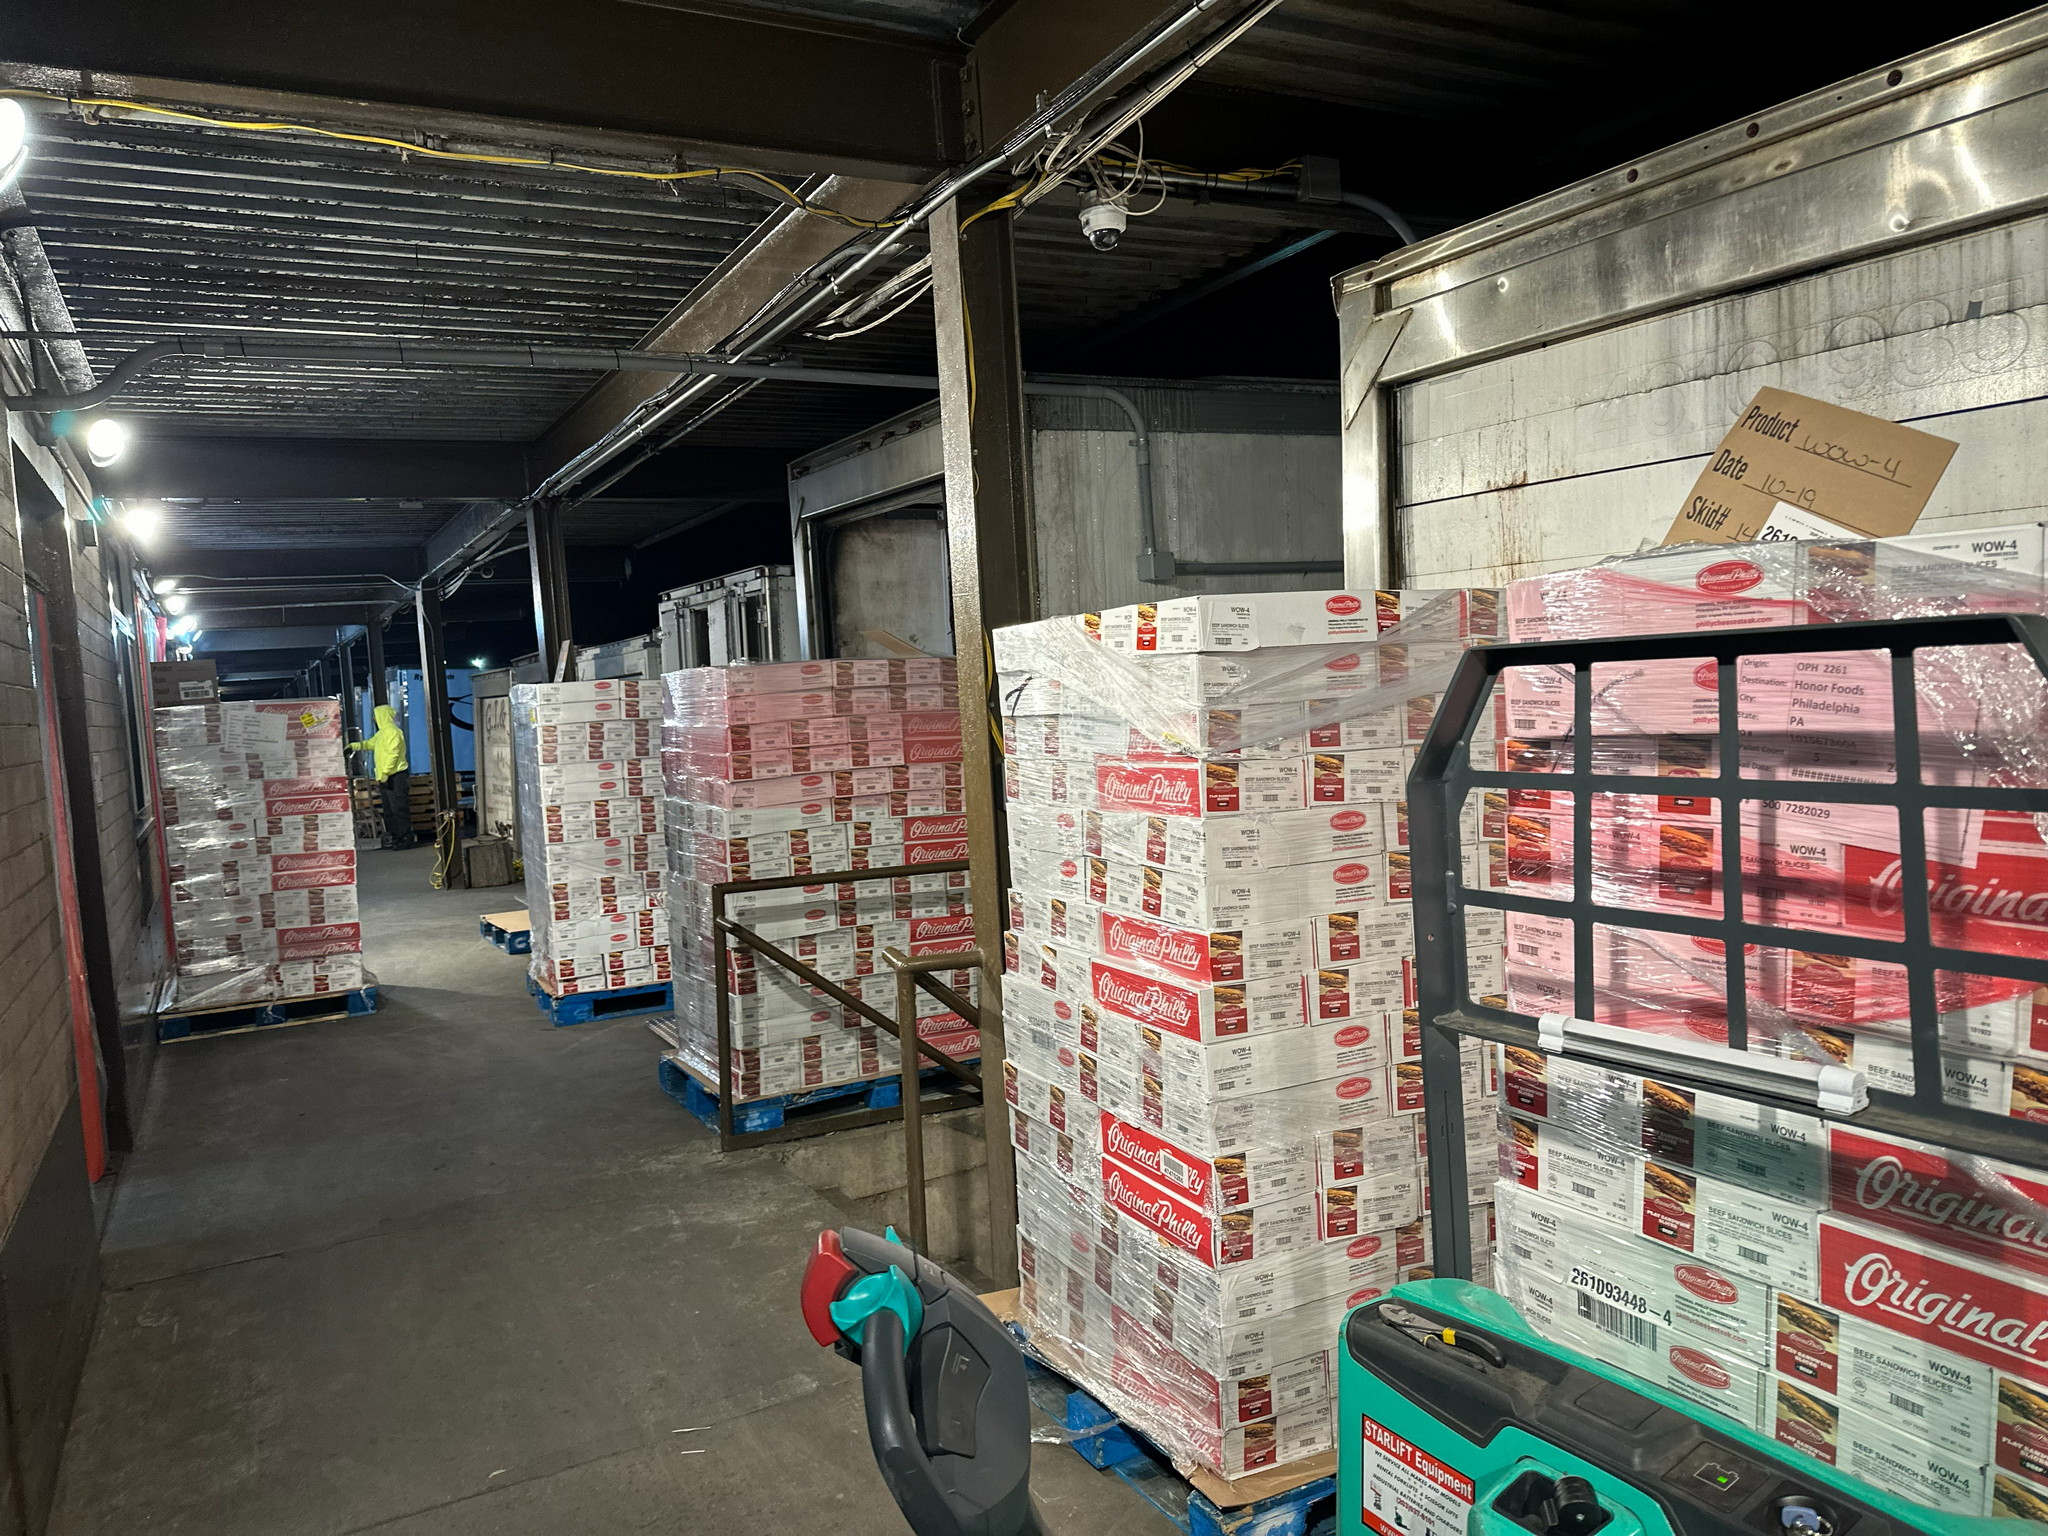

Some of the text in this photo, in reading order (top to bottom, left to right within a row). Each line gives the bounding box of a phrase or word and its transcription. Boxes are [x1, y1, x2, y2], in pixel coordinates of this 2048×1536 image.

[1741, 405, 1799, 443] Product
[1712, 448, 1748, 481] Date
[1686, 495, 1732, 531] Skid#
[1972, 540, 2017, 553] WOW-4
[1966, 560, 1998, 569] SLICES
[1695, 616, 1773, 629] phillycheesesteak.com
[1743, 658, 1848, 675] Origin: OPH 2261
[1741, 675, 1864, 696] Destination: Honor Foods
[1739, 693, 1860, 714] City: Philadelphia
[908, 717, 954, 735] Original
[1737, 711, 1804, 727] State: PA
[910, 743, 955, 760] Original
[1751, 762, 1772, 772] Date:
[1104, 772, 1192, 805] Original Philly
[272, 798, 343, 815] Original Philly
[1786, 803, 1830, 819] 7282029
[910, 820, 958, 838] Original
[911, 846, 958, 864] Original
[1790, 845, 1826, 857] WOW-4
[278, 853, 349, 870] Original Philly
[1745, 857, 1811, 870] SANDWICH SLICES
[278, 872, 350, 889] Original Philly
[284, 926, 356, 943] Original Philly
[916, 921, 962, 940] Original
[1283, 930, 1301, 938] WOW-4
[1525, 926, 1546, 935] SANDWICH
[1546, 929, 1562, 938] SLICES
[1110, 920, 1201, 970] Original Philly
[1872, 967, 1893, 977] BEEF
[1099, 971, 1191, 1026] Original Philly
[1536, 983, 1562, 996] WOW-4
[1232, 1046, 1251, 1055] WOW-4
[1868, 1064, 1889, 1076] BEEF
[1944, 1067, 1988, 1088] WOW-4
[1707, 1120, 1791, 1151] BEEF SANDWICH SLICES
[1770, 1123, 1806, 1142] WOW-4
[1107, 1123, 1160, 1171] Original
[1548, 1149, 1562, 1158] BEEF
[1563, 1152, 1592, 1168] SANDWICH
[1593, 1161, 1613, 1175] SLICES
[1597, 1151, 1625, 1167] WOW-4
[1393, 1183, 1411, 1191] WOW-4
[1109, 1171, 1162, 1222] Original
[1157, 1198, 1203, 1249] Philly
[1293, 1205, 1311, 1213] WOW-4
[1531, 1210, 1556, 1227] WOW-4
[1647, 1209, 1691, 1229] FLAT SANDWICH
[1659, 1219, 1678, 1229] SLICES
[1708, 1206, 1792, 1240] BEEF SANDWICH SLICES
[1772, 1212, 1808, 1231] WOW-4
[1518, 1225, 1555, 1248] SANDWICH SLICES
[1254, 1273, 1274, 1281] WOW-4
[1678, 1268, 1737, 1297] Original Philly
[1528, 1286, 1553, 1305] WOW-4
[1537, 1312, 1552, 1325] SLICES
[1244, 1331, 1264, 1340] WOW-4
[1676, 1312, 1748, 1344] phillycheesesteak.com
[1671, 1350, 1702, 1372] Original
[1781, 1344, 1833, 1370] FLAT SANDWICH
[1795, 1355, 1818, 1369] SLICES
[1853, 1347, 1953, 1393] BEEF SANDWICH SLICES
[1928, 1360, 1971, 1385] WOW-4
[1780, 1431, 1831, 1460] FLAT SANDWICH
[1793, 1443, 1816, 1457] SLICES
[2002, 1437, 2024, 1450] FLAT
[1365, 1420, 1473, 1499] STARLIFT Equipment
[1852, 1441, 1951, 1494] BEEF SANDWICH SLICES
[1383, 1454, 1401, 1470] SERVICE
[1401, 1467, 1410, 1476] ALL
[1410, 1472, 1428, 1486] MAKES
[1428, 1484, 1440, 1494] AND
[1440, 1491, 1461, 1508] MODELS
[1928, 1461, 1970, 1489] WOW-4
[1377, 1463, 1393, 1477] RENTAL
[1394, 1474, 1418, 1493] FORKLIFTS
[1424, 1494, 1446, 1511] SCISSOR
[1446, 1507, 1459, 1519] LIFTS
[1373, 1473, 1399, 1494] INDUSTRIAL
[1400, 1491, 1423, 1511] BATTERIES
[1424, 1507, 1436, 1517] AND
[1436, 1514, 1463, 1536] CHARGERS
